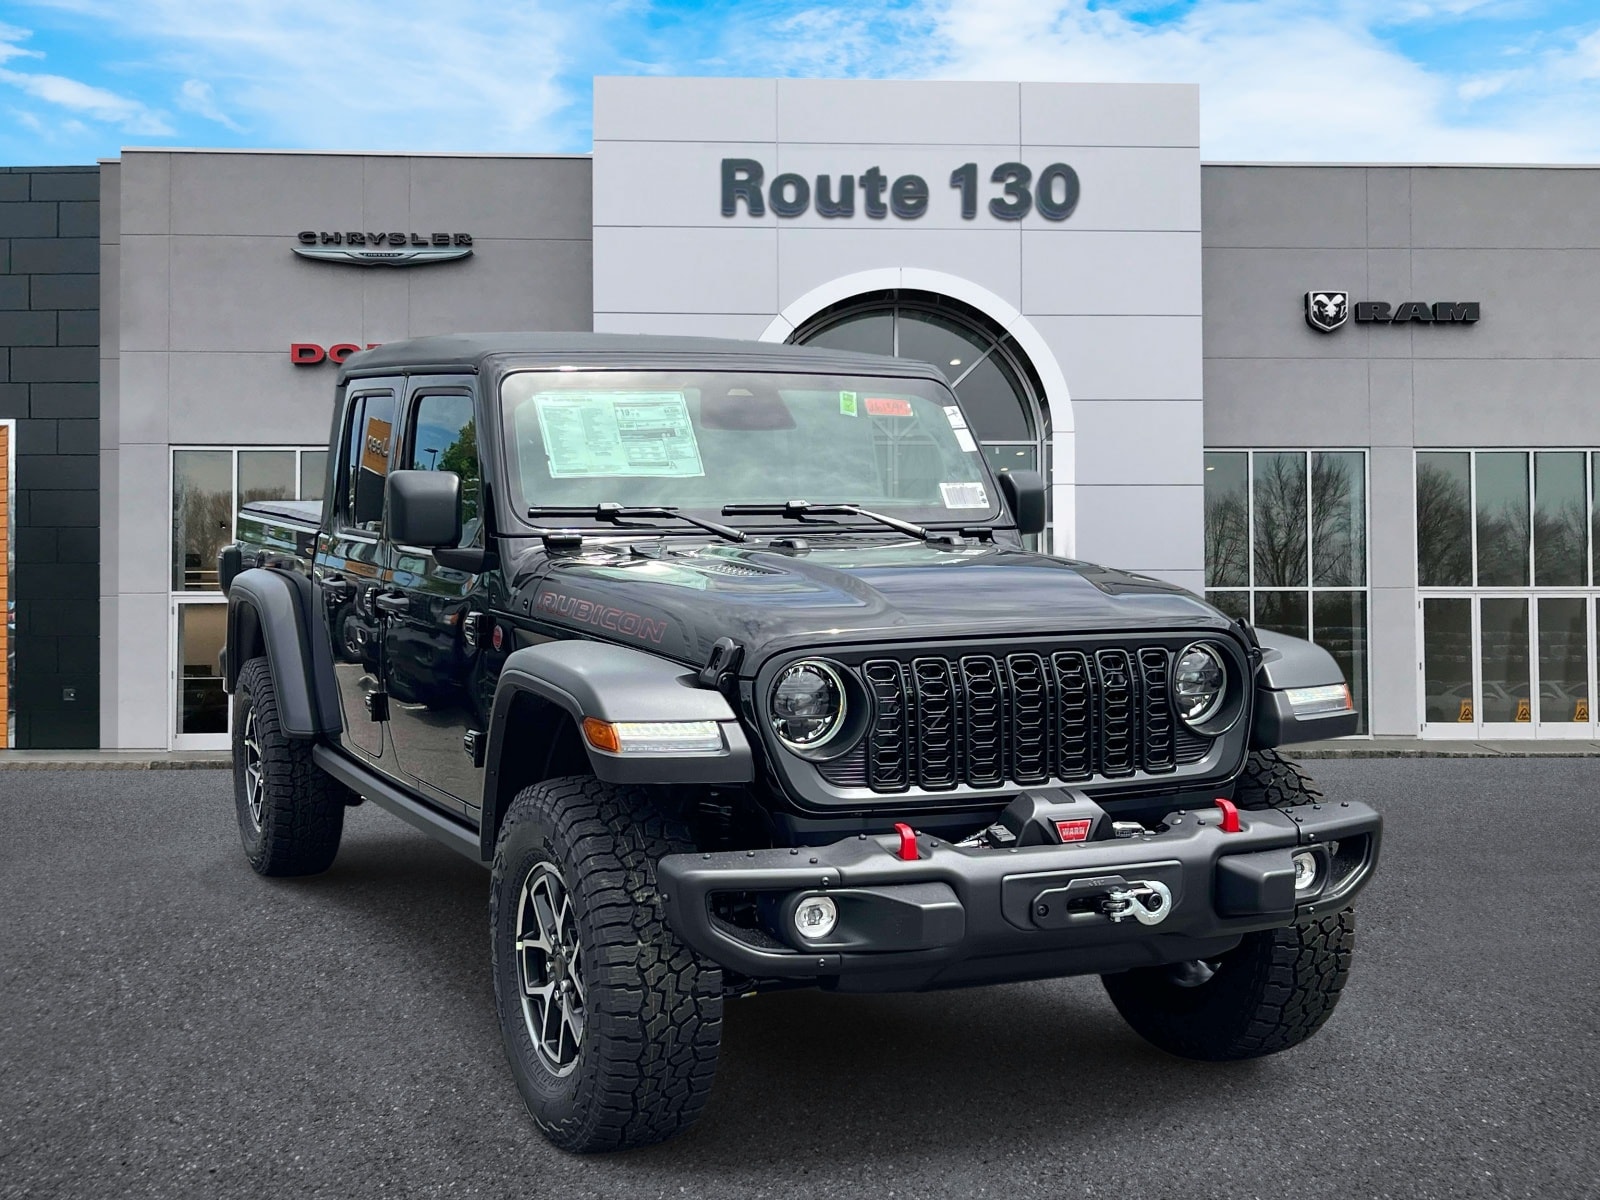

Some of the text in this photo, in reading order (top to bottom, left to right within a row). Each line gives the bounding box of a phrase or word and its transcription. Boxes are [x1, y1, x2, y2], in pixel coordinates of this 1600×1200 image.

[721, 158, 1080, 221] Route 130
[297, 231, 473, 246] CHRYSLER
[1355, 301, 1480, 324] RAM
[290, 343, 382, 364] DO
[537, 591, 668, 643] RUBICON
[1062, 826, 1085, 836] WARN
